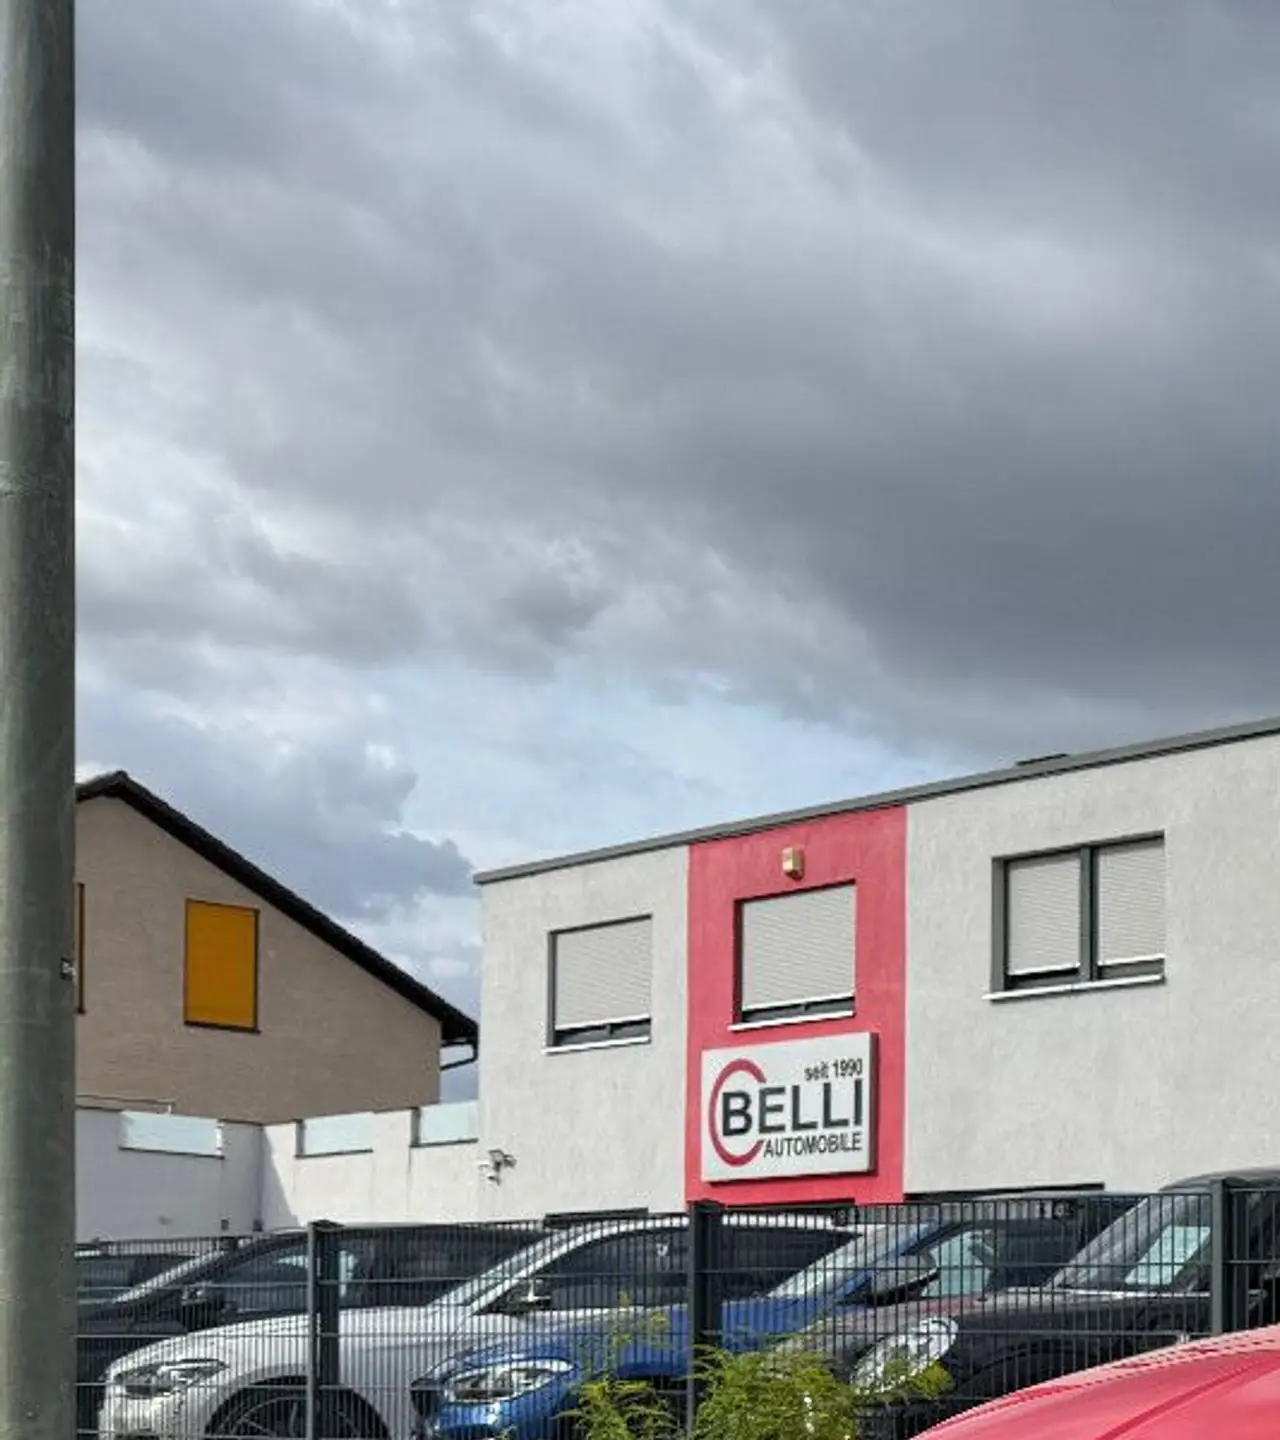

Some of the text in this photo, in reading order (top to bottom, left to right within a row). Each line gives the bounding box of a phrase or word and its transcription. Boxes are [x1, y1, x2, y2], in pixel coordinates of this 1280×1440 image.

[803, 1058, 863, 1082] seit 1990
[722, 1077, 863, 1137] BELLI
[763, 1131, 863, 1159] AUTOMOBILE
